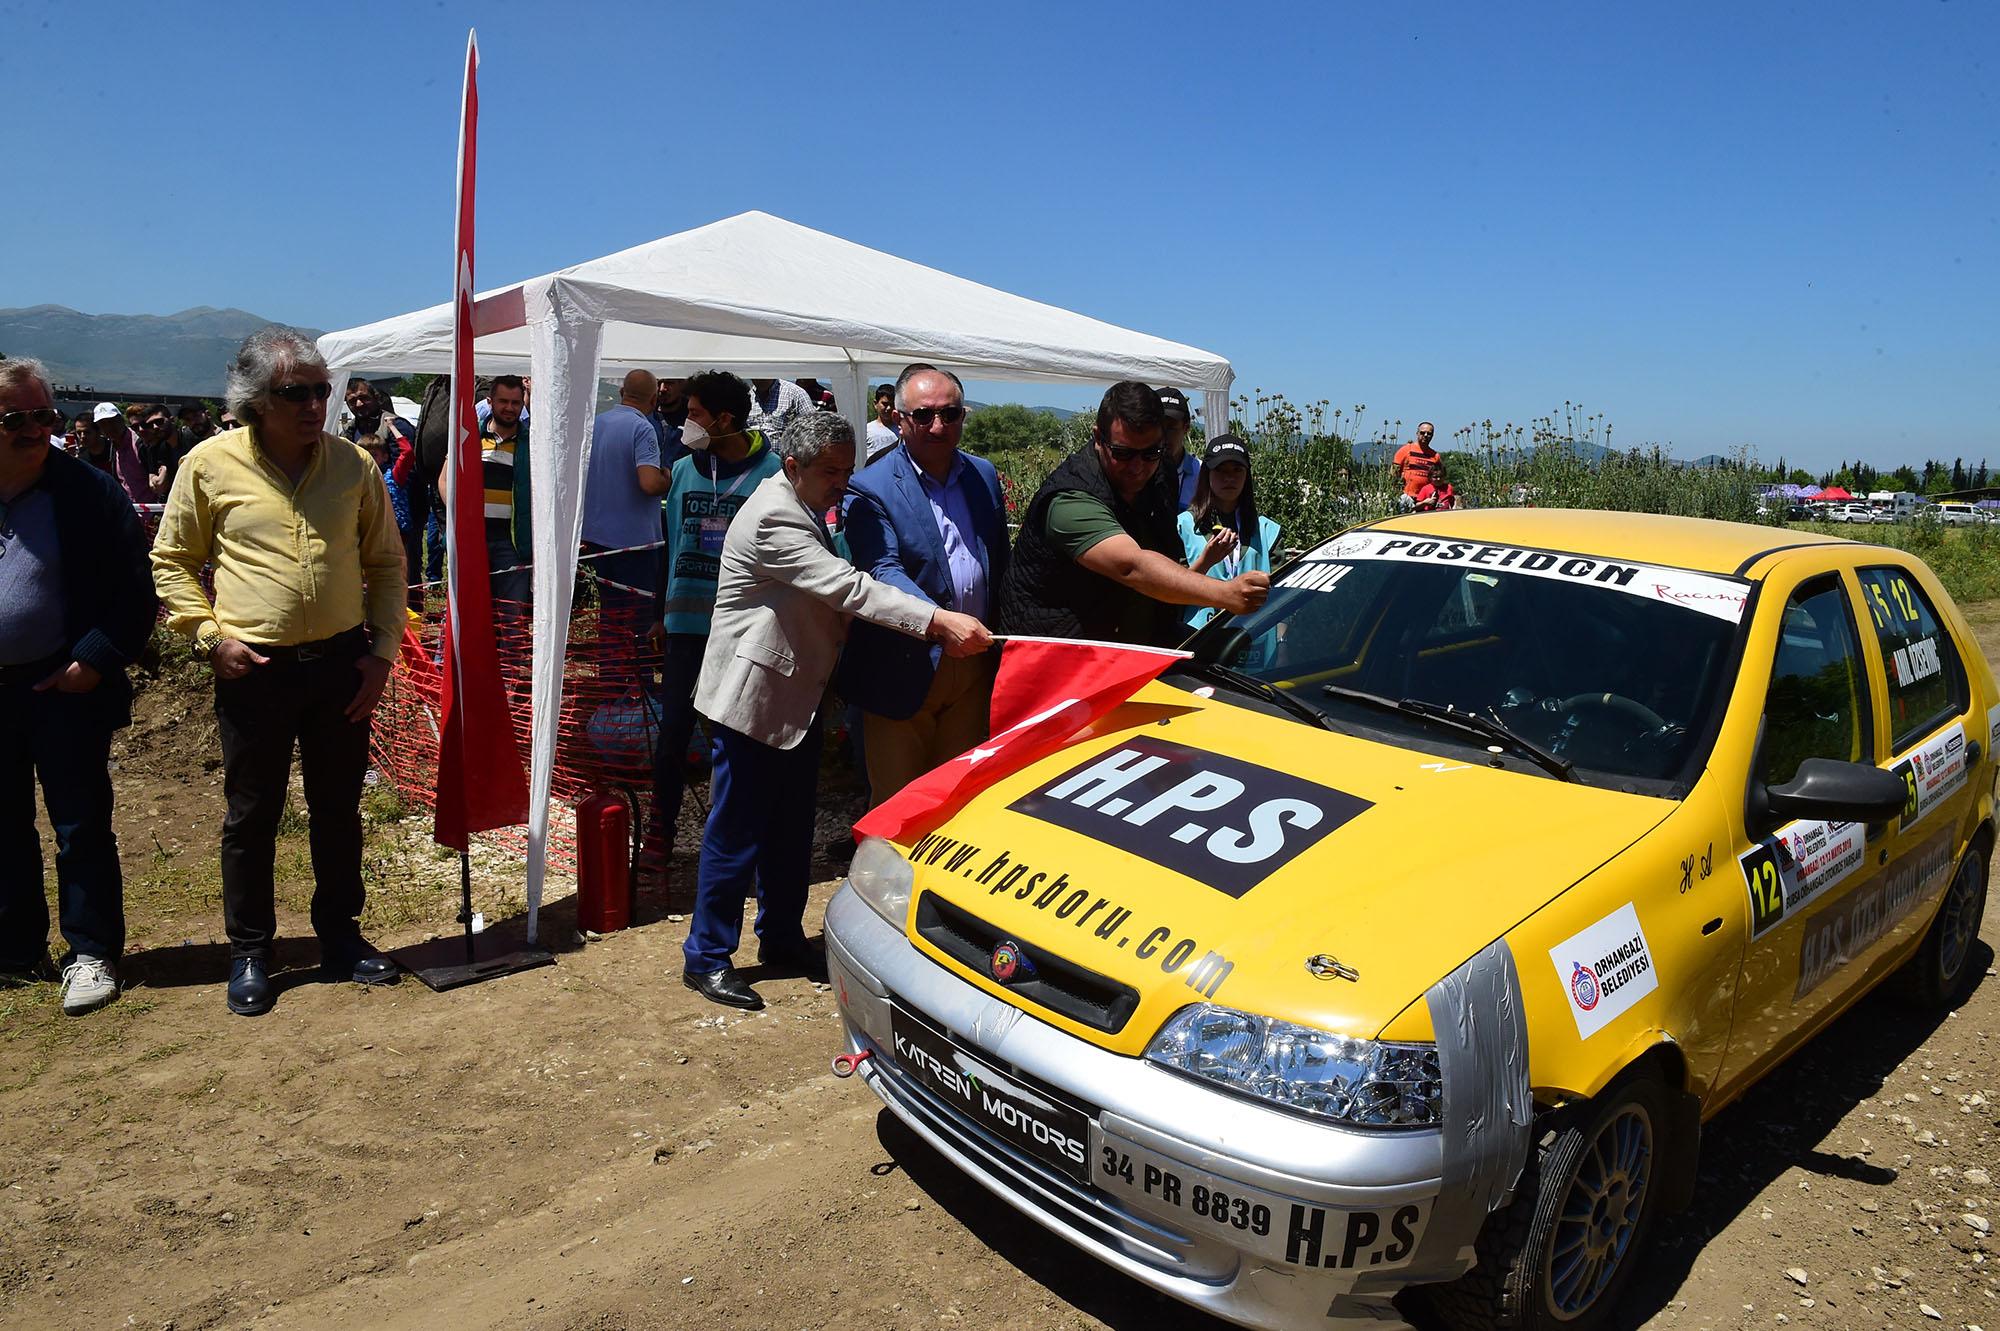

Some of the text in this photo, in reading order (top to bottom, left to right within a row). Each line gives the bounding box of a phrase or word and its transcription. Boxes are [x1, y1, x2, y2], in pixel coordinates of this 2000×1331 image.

[1274, 562, 1355, 593] ANIL
[1376, 539, 1748, 613] POSEIDON Racing
[1890, 578, 1919, 621] 12
[1044, 748, 1323, 864] H.P.S
[908, 832, 1236, 998] www.hpsboru.com
[1752, 860, 1780, 918] 12
[1594, 932, 1644, 978] ORHANGAZİ
[1601, 950, 1650, 998] BELEDİYESİ
[894, 1030, 1085, 1165] KATREN MOTORS
[1102, 1145, 1271, 1237] 34 PR 8839
[1286, 1204, 1420, 1269] H.P.S
